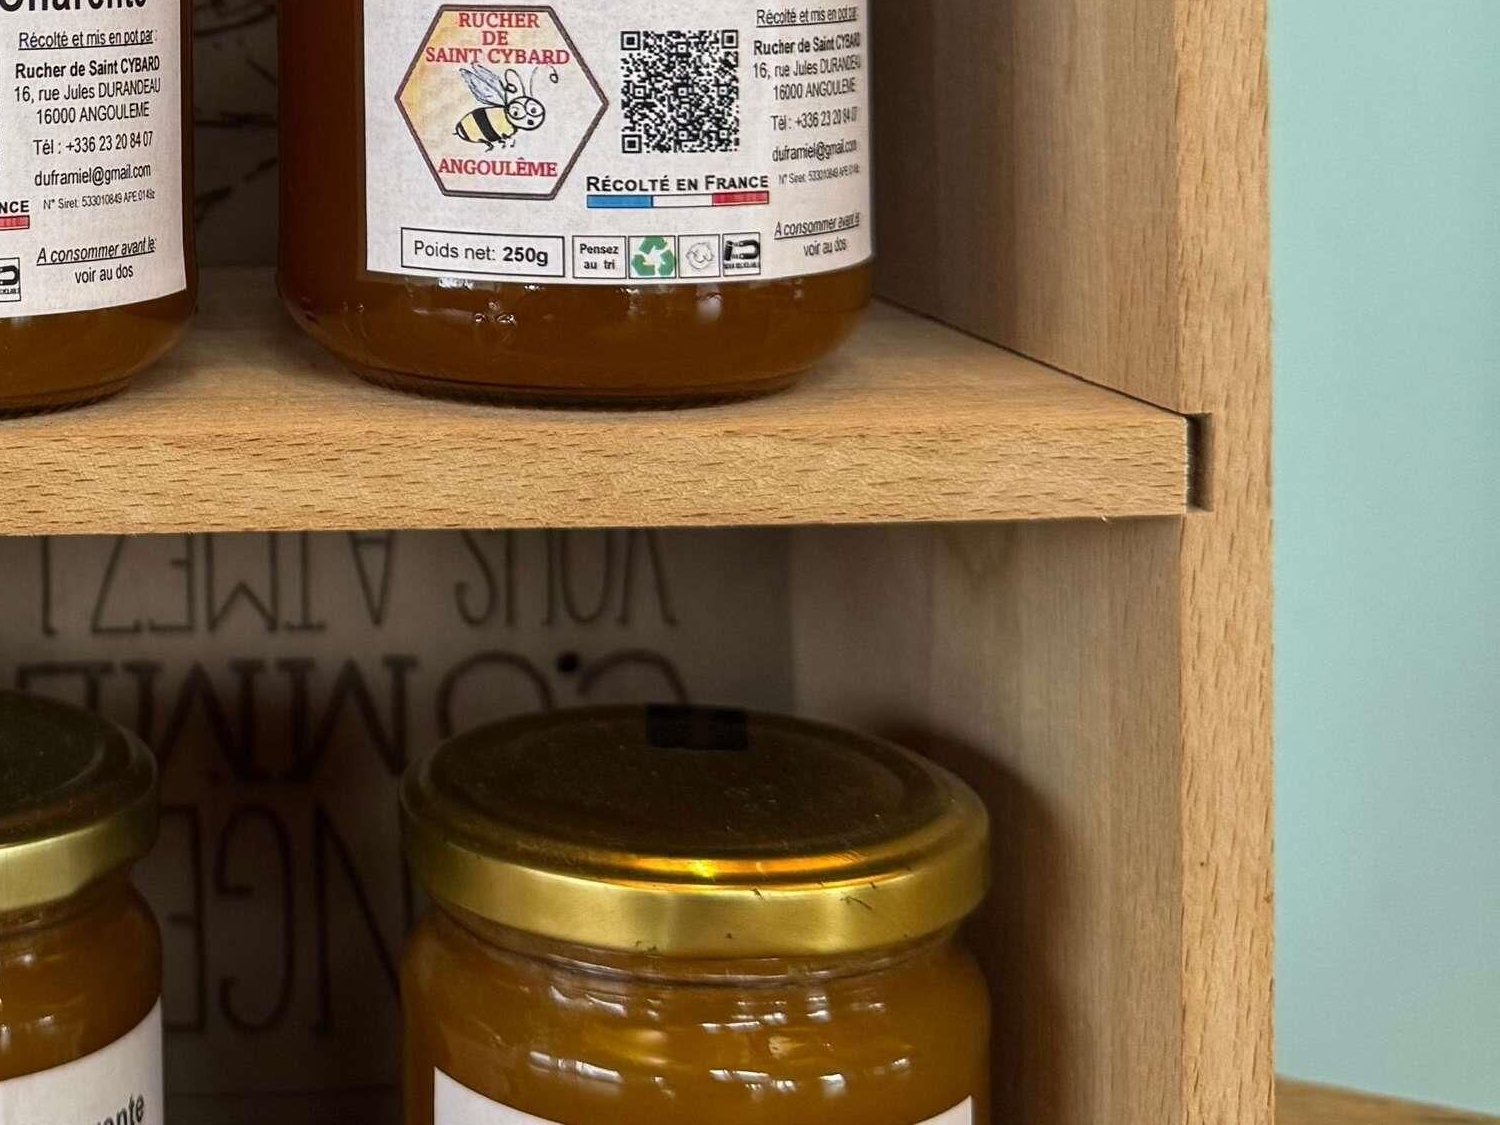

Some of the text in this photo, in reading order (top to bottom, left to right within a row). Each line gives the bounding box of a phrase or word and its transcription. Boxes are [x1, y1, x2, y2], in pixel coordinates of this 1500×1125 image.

[458, 13, 540, 28] RUCHER
[757, 9, 796, 24] Récolté
[19, 30, 139, 48] Récolté et mis en pot
[482, 31, 508, 46] DE
[754, 38, 810, 55] Rucher de
[425, 48, 570, 65] SAINT CYBARD
[15, 56, 160, 79] Rucher de Saint CYBARD
[753, 61, 818, 79] 16, rue Jules
[14, 78, 161, 103] 16, rue Jules DURANDEAU
[773, 84, 802, 100] 16000
[36, 101, 150, 125] 16000 ANGOULEME
[795, 112, 818, 128] +336
[33, 131, 153, 155] Tél +336 23 20 84 07
[34, 164, 151, 186] duframiel@gmail.com
[438, 157, 558, 178] ANGOULÊME
[587, 176, 669, 192] RÉCOLTÉ
[704, 175, 769, 190] FRANCE
[37, 239, 146, 264] A consommer avant
[414, 240, 548, 267] Poids net: 250g
[579, 242, 619, 256] Pensez
[804, 240, 833, 256] voir au
[584, 259, 615, 270] au tri
[74, 264, 134, 283] voir au dos
